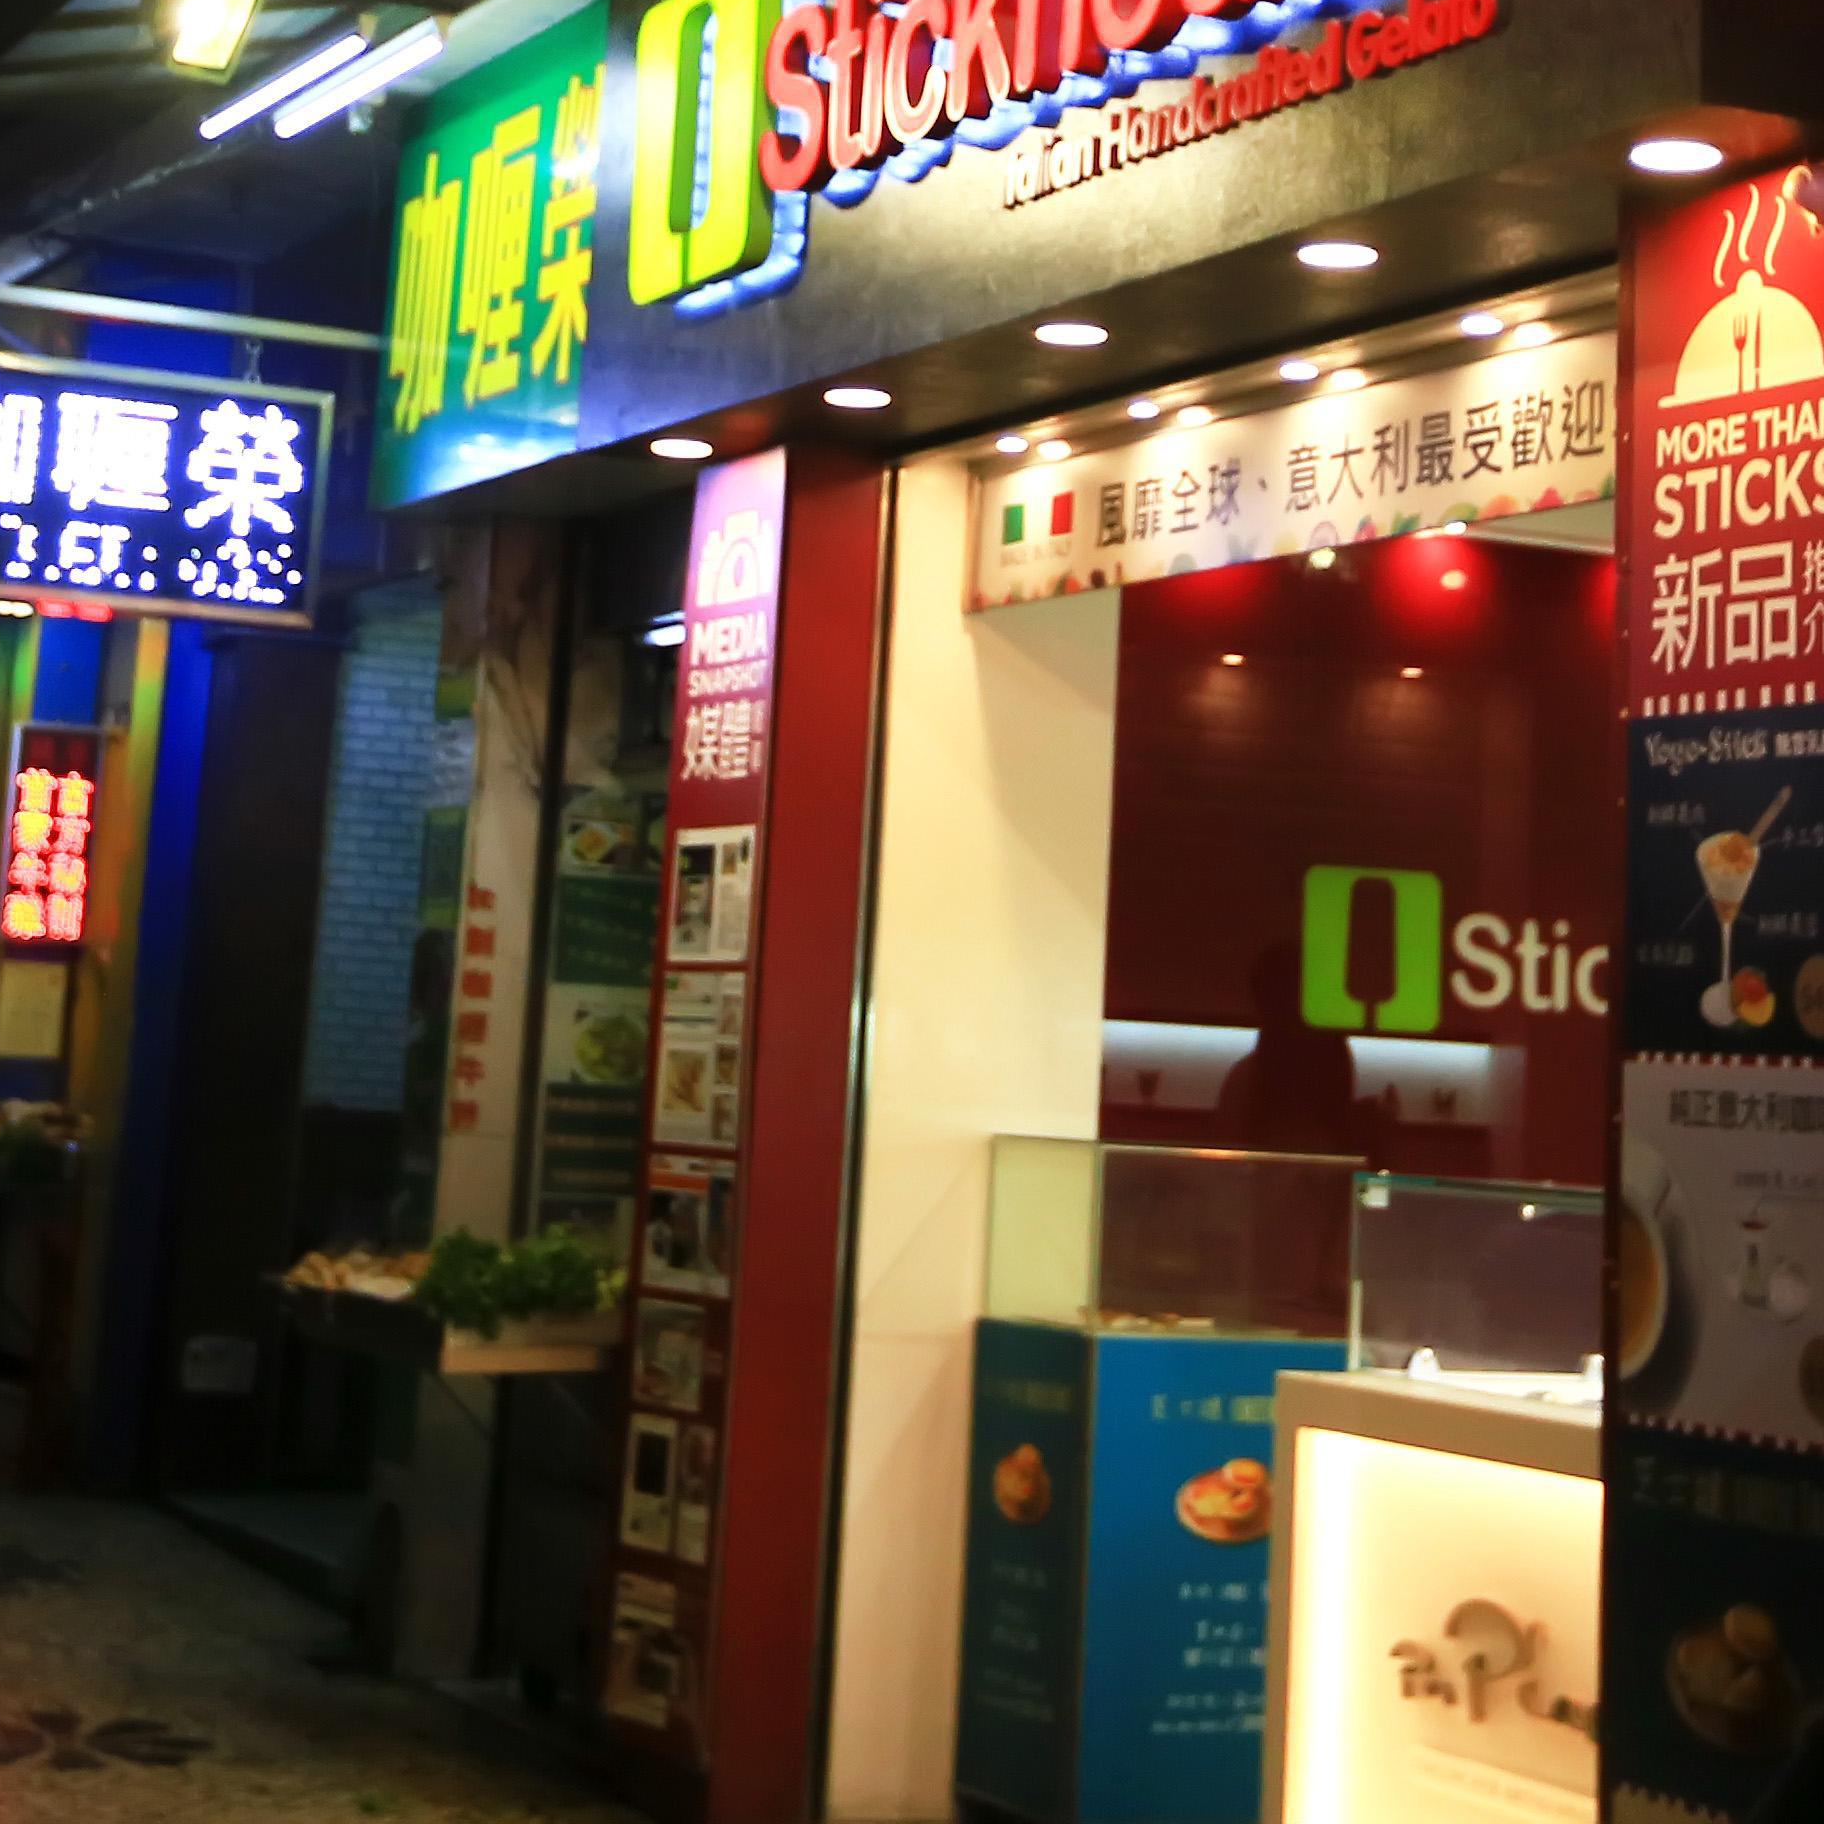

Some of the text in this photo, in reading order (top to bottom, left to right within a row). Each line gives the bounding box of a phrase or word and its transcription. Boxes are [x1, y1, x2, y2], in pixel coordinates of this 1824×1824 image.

[1103, 16, 1342, 170] Handcrafted
[1656, 412, 1746, 468] MORE
[689, 610, 769, 667] MEDIA
